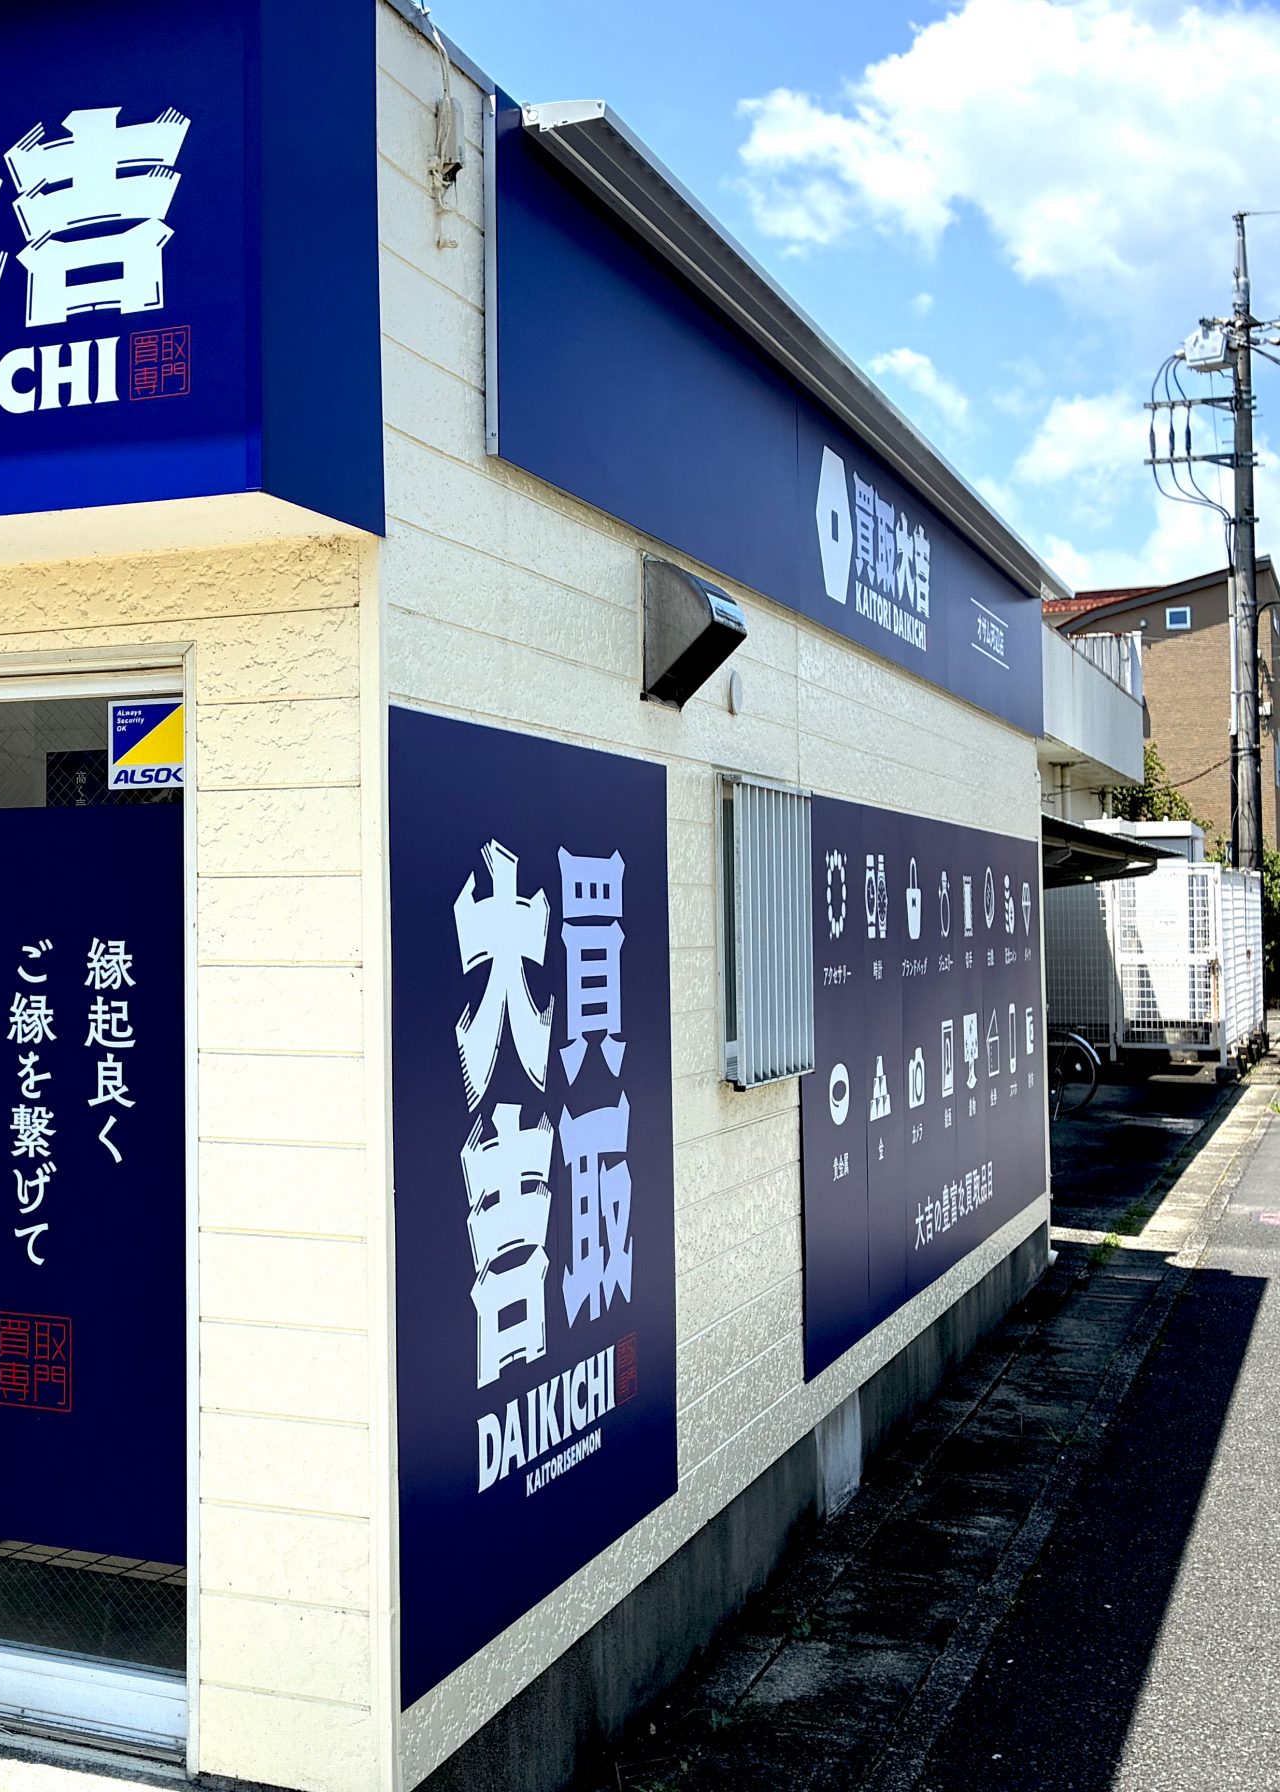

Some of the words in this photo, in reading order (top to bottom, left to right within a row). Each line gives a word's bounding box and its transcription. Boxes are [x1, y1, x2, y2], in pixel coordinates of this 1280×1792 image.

[853, 472, 930, 618] 買取大吉
[856, 581, 892, 630] KAITORI
[893, 608, 927, 652] DAIKICHI
[113, 767, 184, 785] ALSOK
[823, 964, 852, 986] アクセサリー
[84, 938, 136, 1163] 縁起良く
[558, 846, 632, 1328] 買取
[7, 939, 57, 1265] ご縁を繋げて
[454, 839, 554, 1389] 大吉
[833, 1152, 849, 1182] 貴金属
[915, 1161, 993, 1250] 大吉の豊富な買取品目
[0, 1319, 66, 1361] 買取
[477, 1345, 616, 1493] DAIKICHI
[527, 1428, 602, 1497] KAITORISENMON
